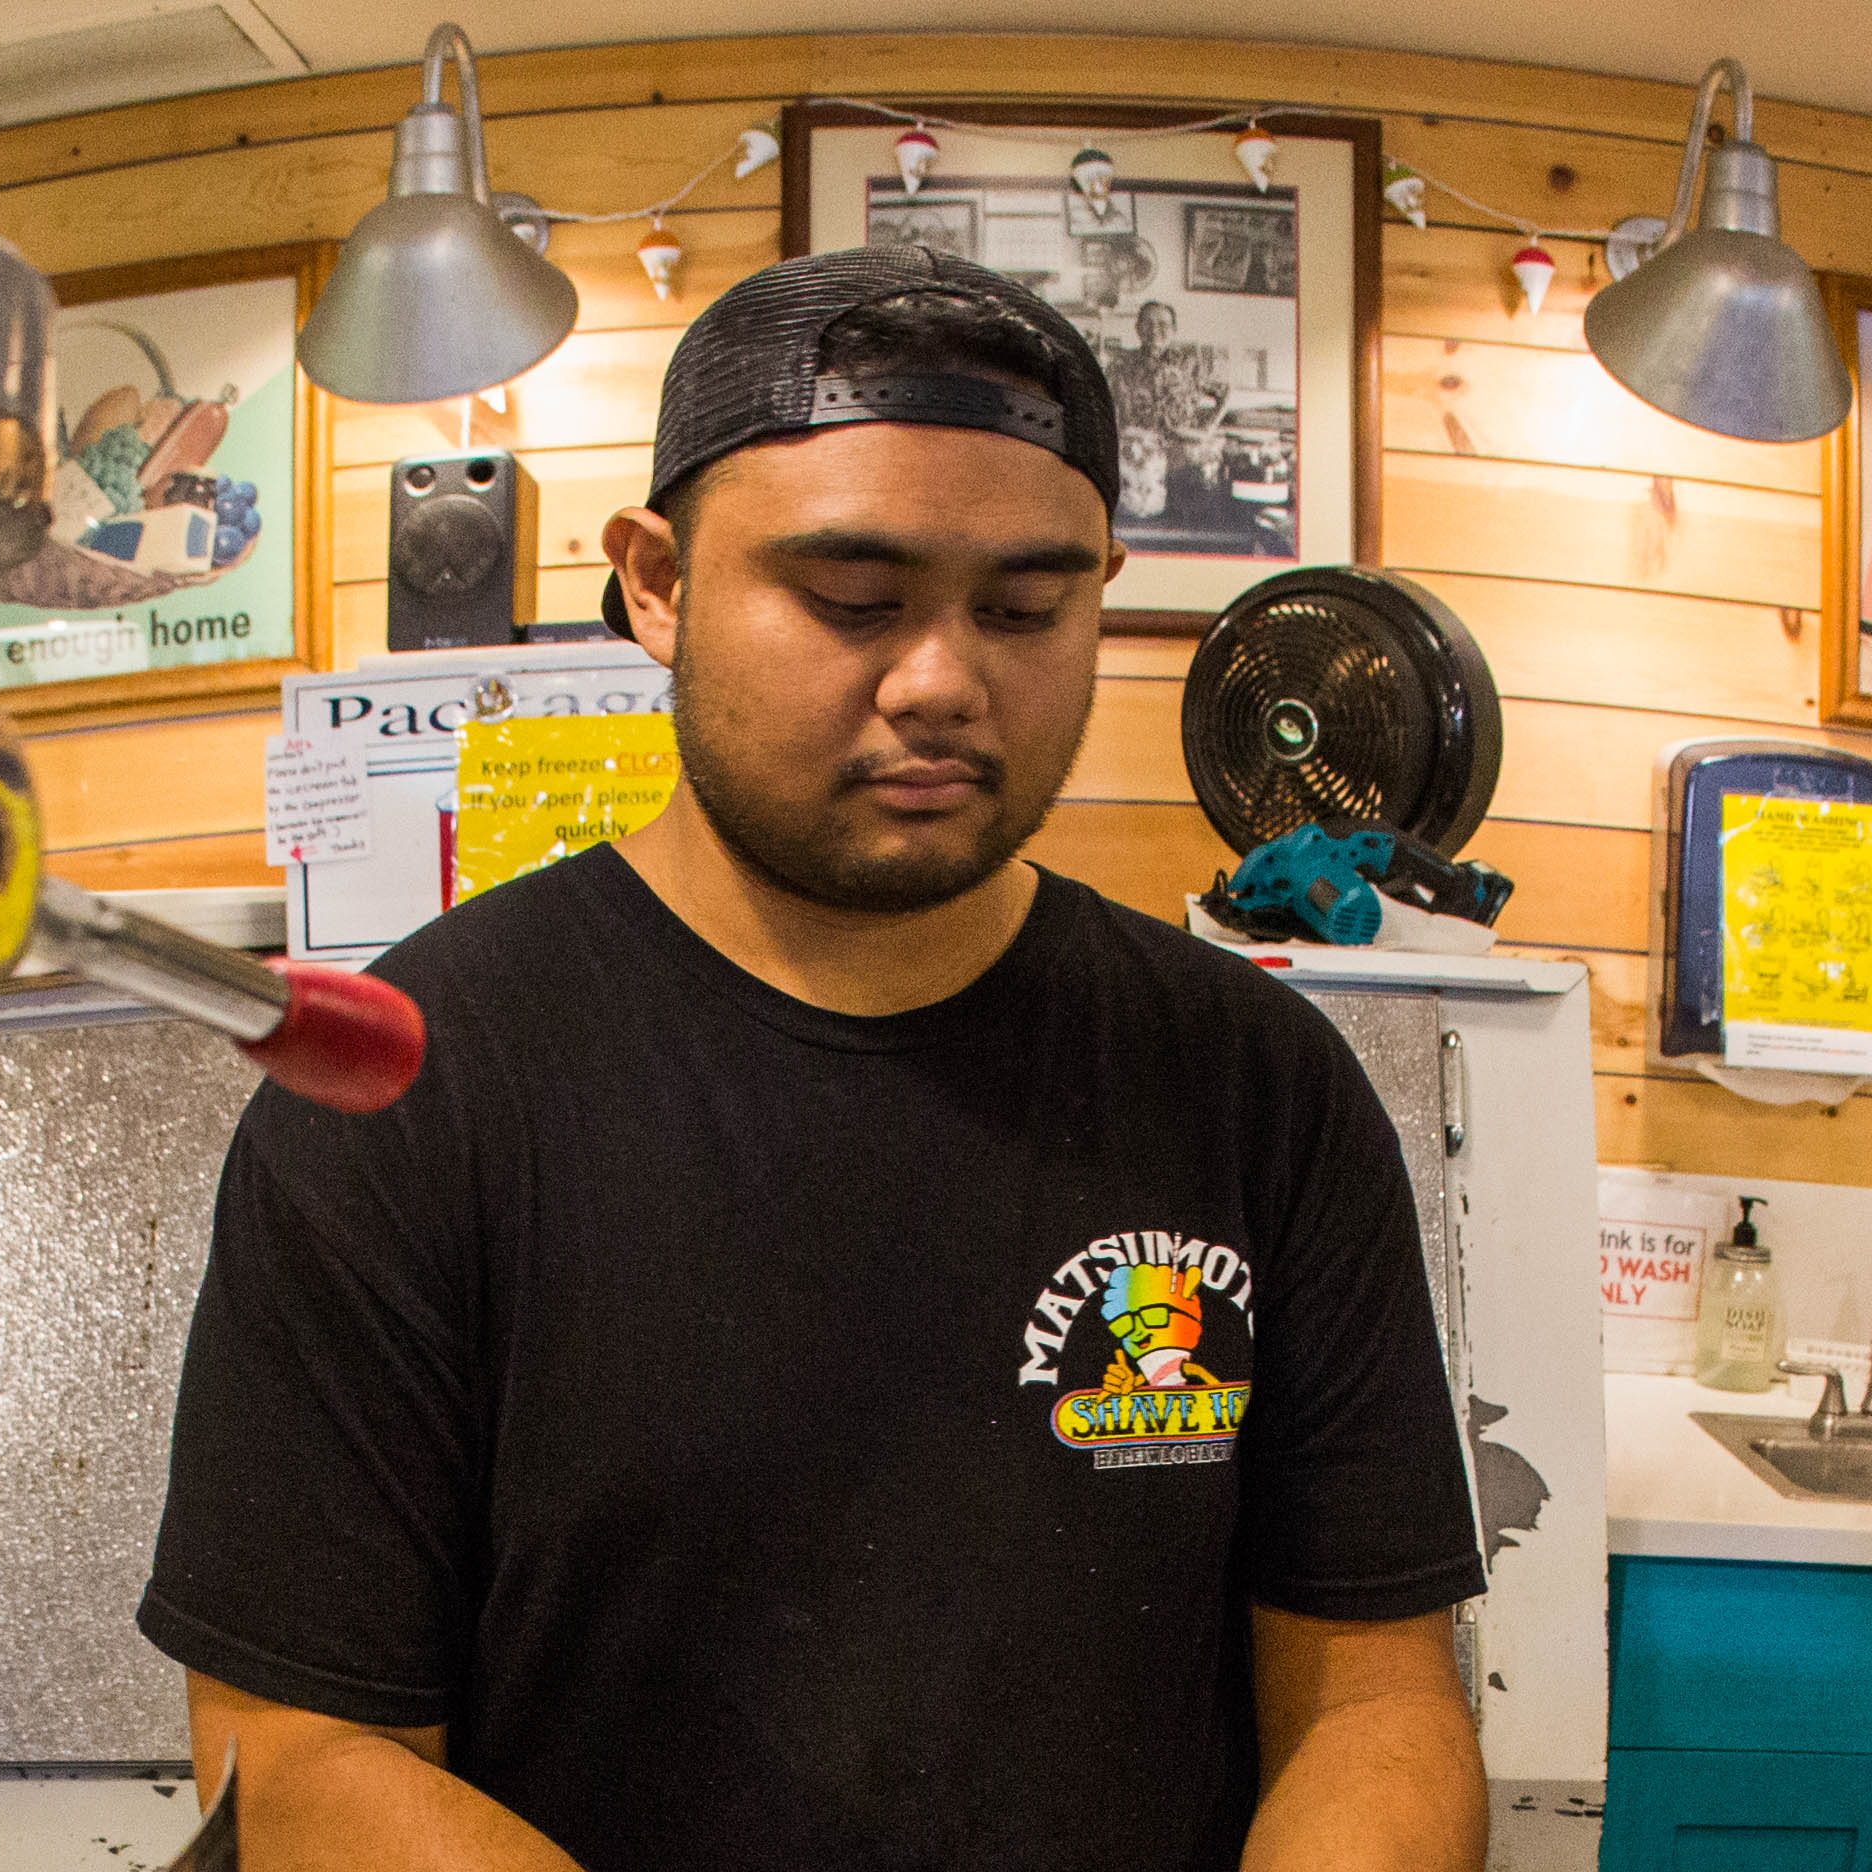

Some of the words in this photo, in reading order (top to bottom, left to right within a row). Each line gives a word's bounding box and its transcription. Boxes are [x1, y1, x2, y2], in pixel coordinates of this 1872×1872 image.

[6, 613, 137, 666] enough
[149, 608, 251, 648] home
[481, 757, 531, 778] Keep
[470, 793, 484, 809] If
[489, 794, 526, 811] you
[597, 785, 664, 806] please
[555, 817, 629, 840] quickly
[1599, 1229, 1632, 1251] ink
[1640, 1231, 1656, 1253] is
[1663, 1233, 1696, 1256] for
[1617, 1255, 1691, 1285] WASH
[1599, 1282, 1648, 1307] NLY
[1071, 1394, 1201, 1439] SHAVE
